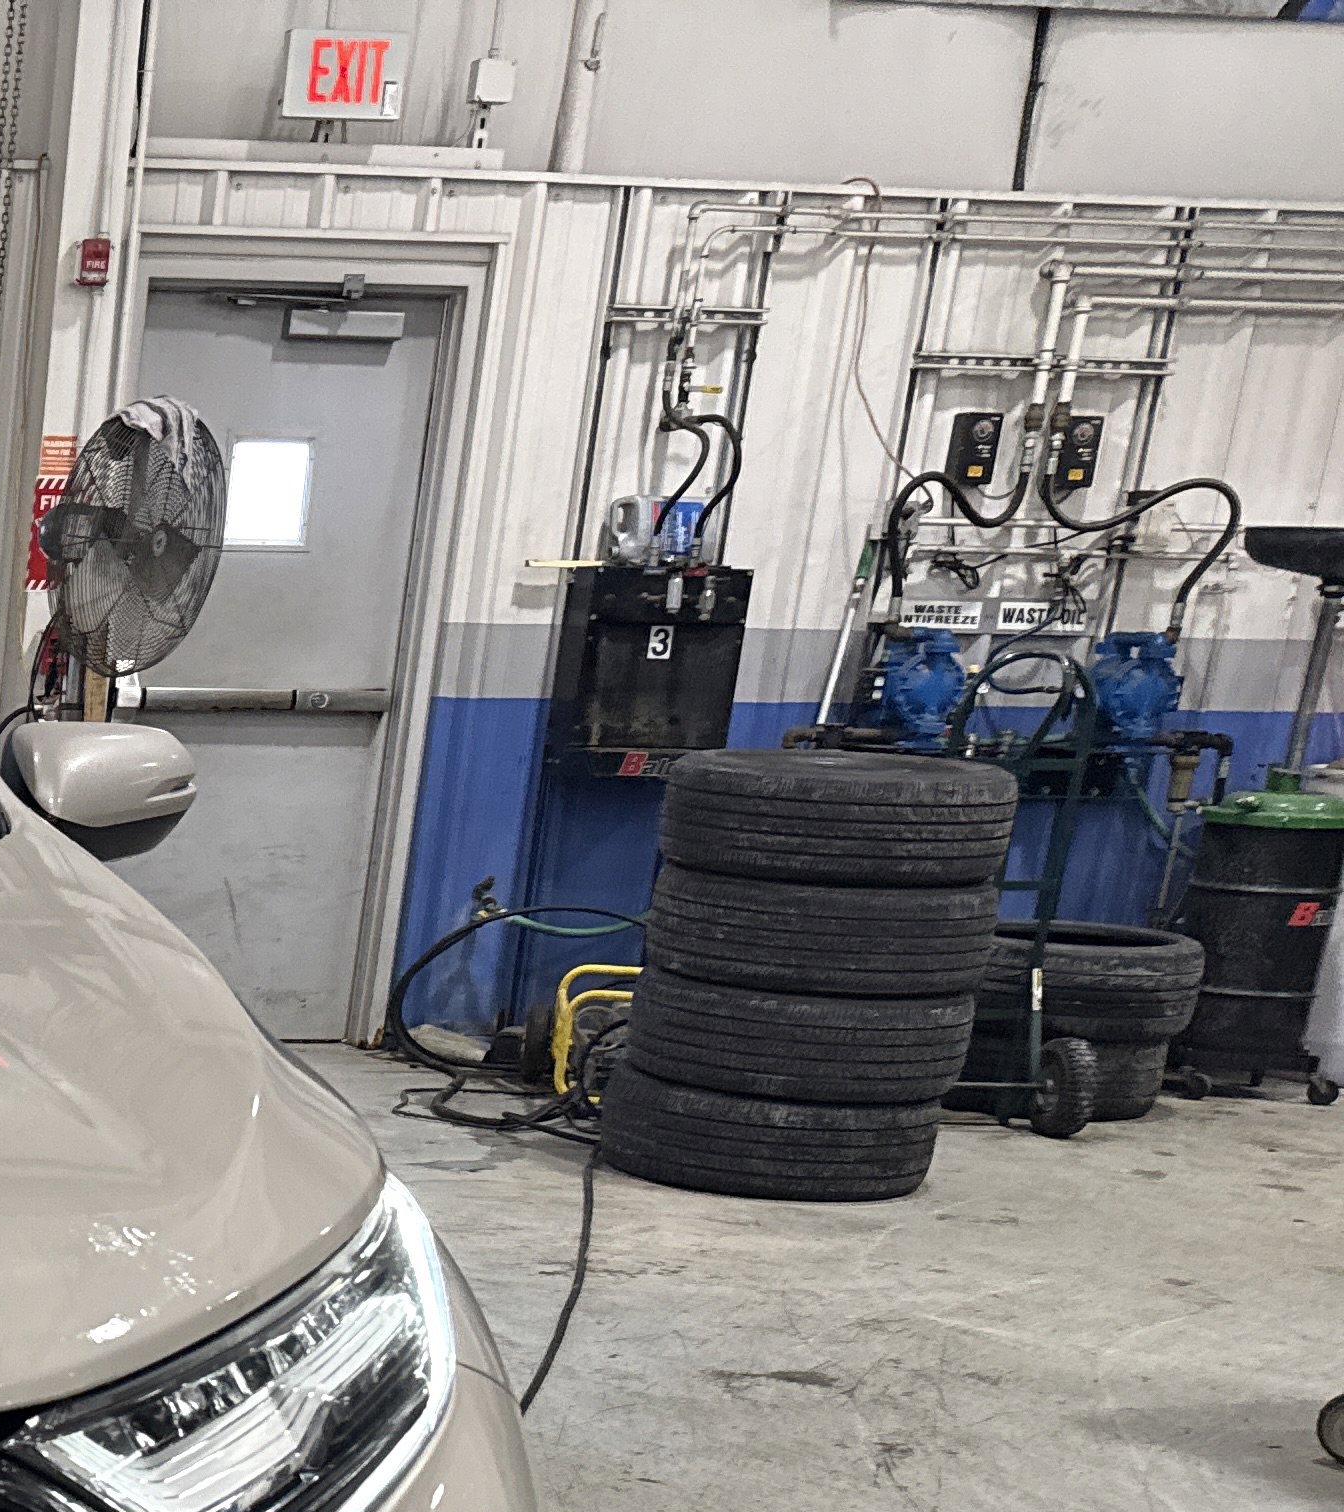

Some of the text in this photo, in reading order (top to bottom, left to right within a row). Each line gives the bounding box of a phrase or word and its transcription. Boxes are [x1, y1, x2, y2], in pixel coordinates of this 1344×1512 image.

[307, 37, 392, 105] EXIT
[86, 260, 107, 270] FIRE
[914, 604, 963, 614] WASTE
[899, 613, 978, 625] NTIFREEZE
[651, 628, 670, 656] 3
